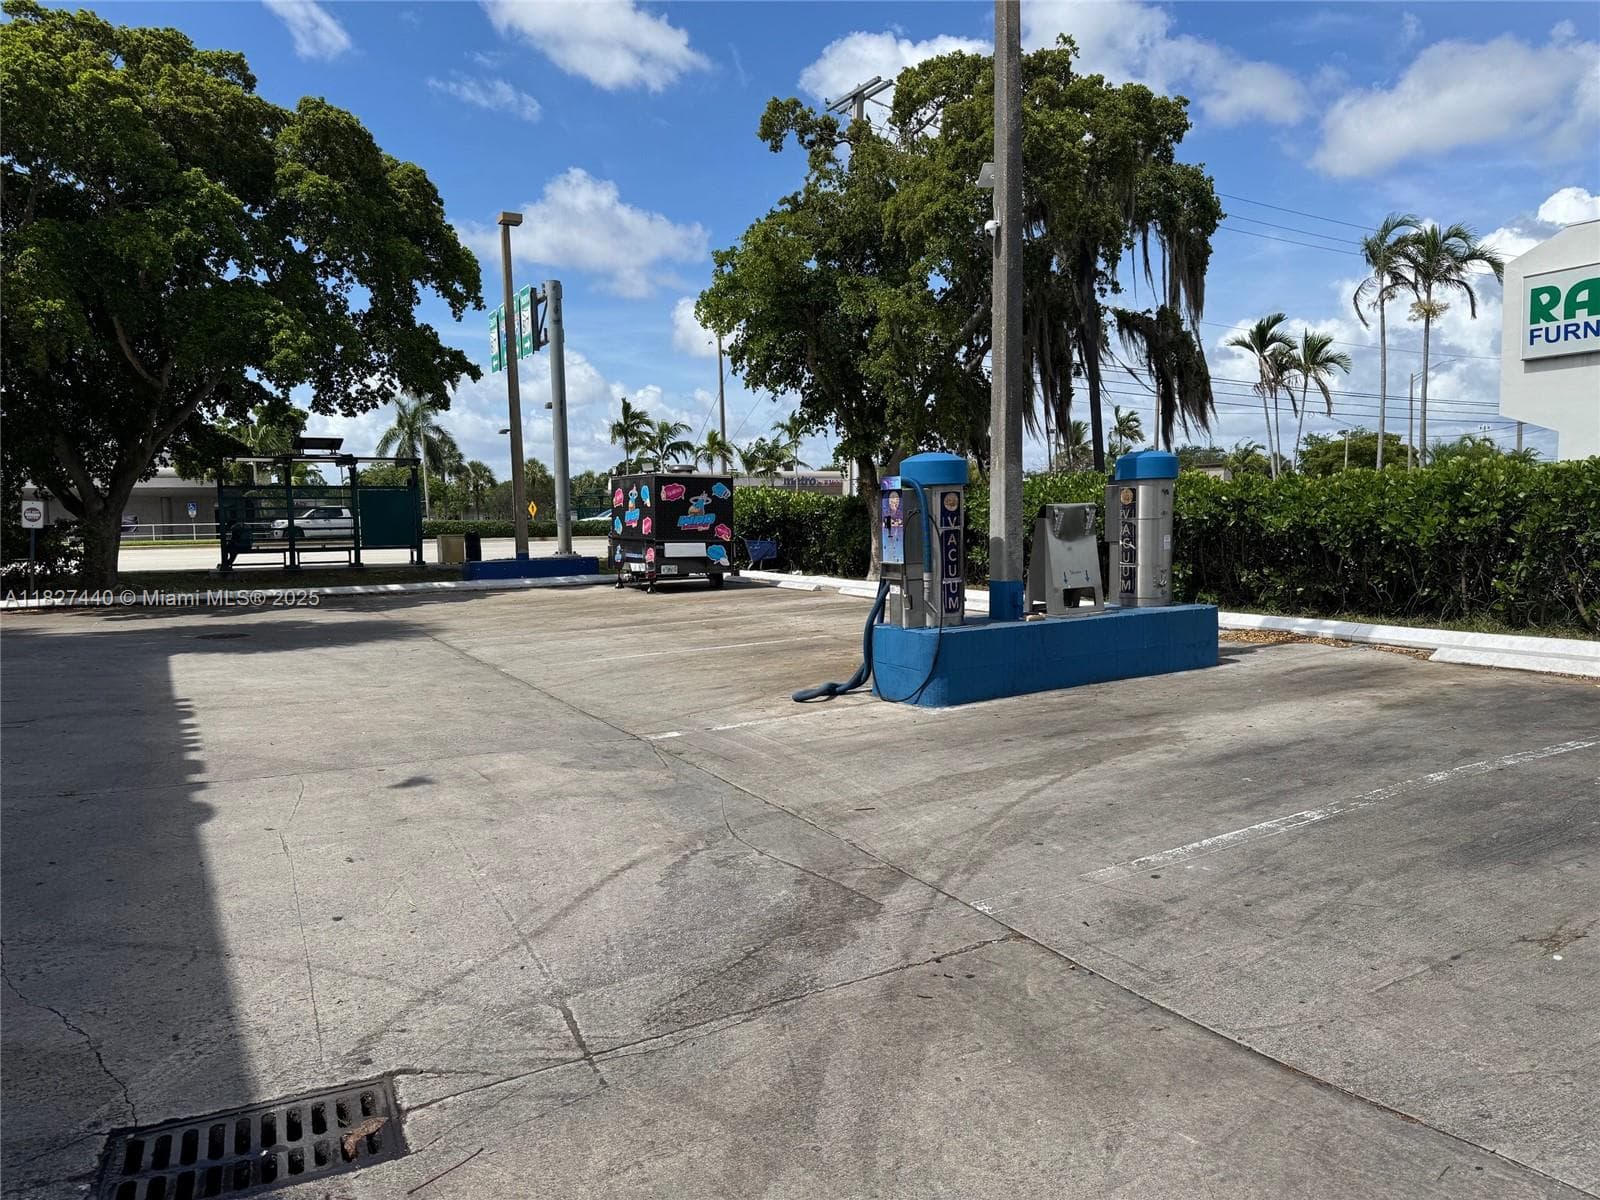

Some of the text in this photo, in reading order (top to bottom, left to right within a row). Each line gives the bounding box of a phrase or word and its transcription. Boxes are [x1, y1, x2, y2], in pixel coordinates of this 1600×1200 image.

[1529, 320, 1600, 346] FURN
[947, 516, 960, 610] VACUUM
[1121, 509, 1131, 591] VACUUM
